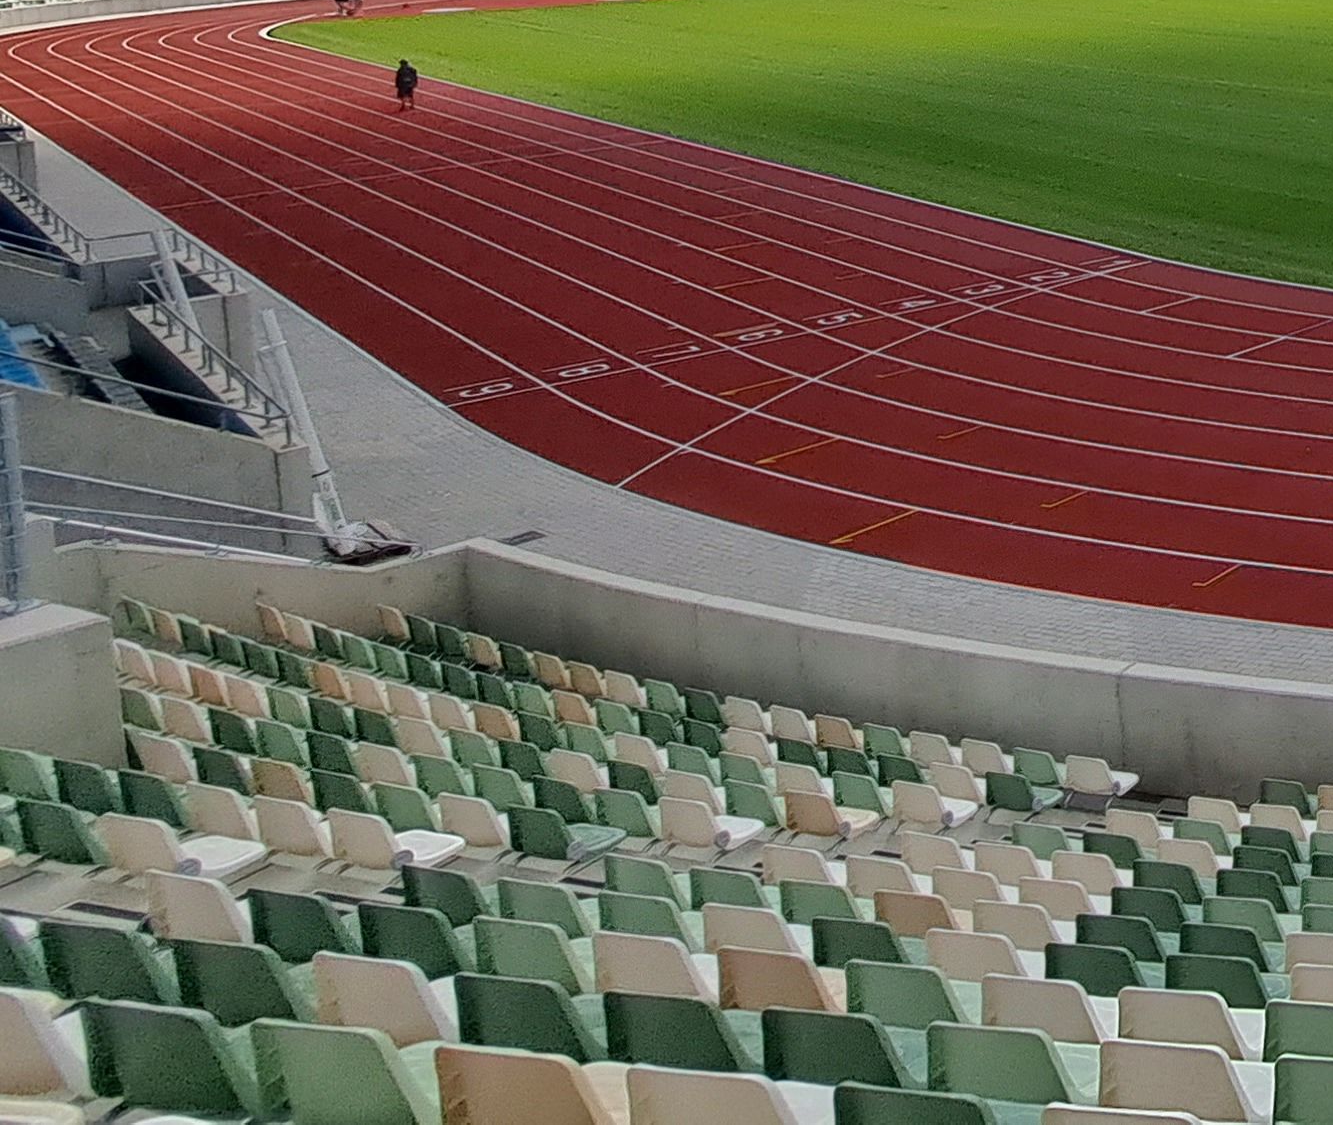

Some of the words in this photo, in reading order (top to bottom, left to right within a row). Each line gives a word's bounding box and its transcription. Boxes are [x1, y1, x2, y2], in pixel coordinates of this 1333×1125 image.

[1099, 259, 1131, 268] 1
[1030, 271, 1070, 282] 2
[964, 284, 1004, 295] 3
[899, 299, 937, 309] 4
[817, 312, 864, 326] 5
[738, 328, 784, 342] 6
[652, 345, 701, 358] 7
[558, 363, 611, 377] 8
[458, 382, 514, 398] 9
